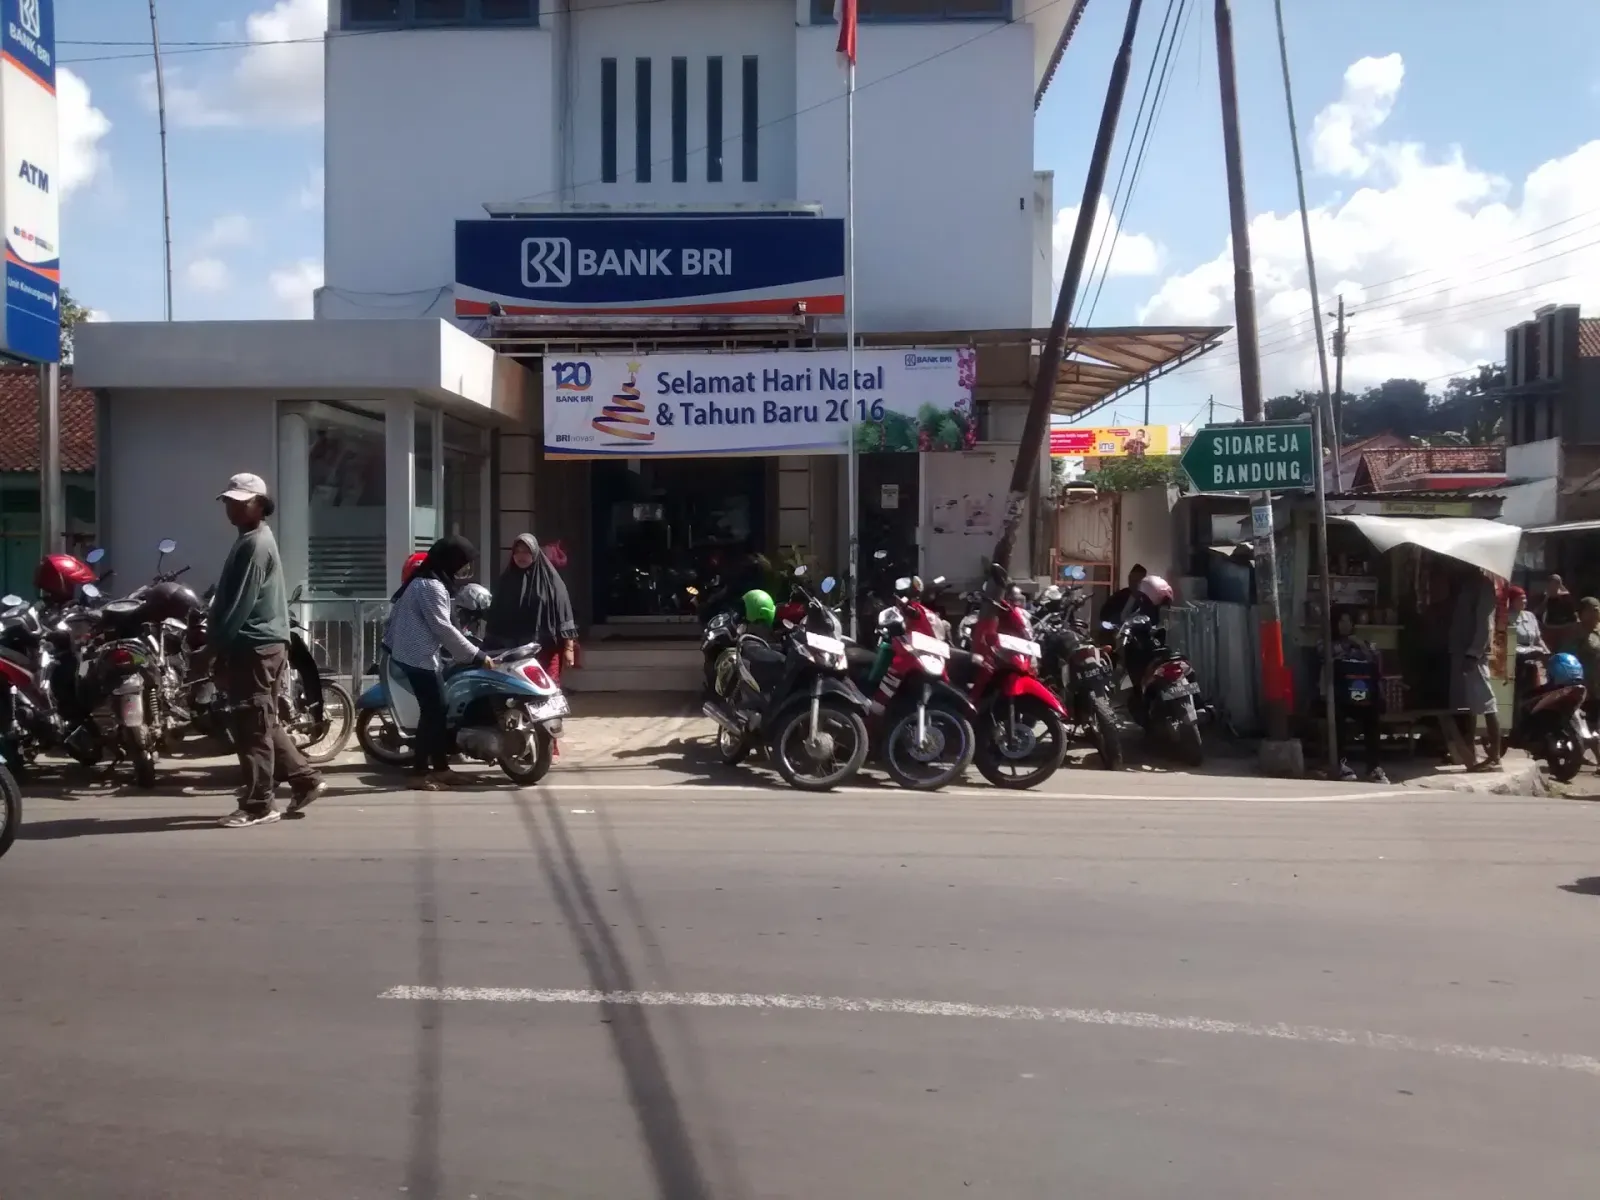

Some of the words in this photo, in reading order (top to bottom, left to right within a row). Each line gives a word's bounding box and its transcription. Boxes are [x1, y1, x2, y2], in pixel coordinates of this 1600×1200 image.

[9, 21, 36, 55] BANK
[37, 44, 51, 67] BRI
[19, 160, 49, 193] ATM
[577, 248, 672, 276] BANK
[682, 248, 732, 276] BRI
[939, 355, 952, 363] BRI
[551, 362, 592, 391] 120
[657, 370, 756, 395] Selamat
[763, 367, 811, 392] Hari
[819, 365, 883, 391] Natal
[556, 395, 579, 403] BANK
[580, 395, 594, 403] BRI
[656, 402, 674, 426] &
[680, 401, 755, 426] Tahun
[763, 400, 818, 424] Baru
[825, 398, 885, 423] 2016
[1213, 433, 1299, 456] SIDAREJA
[1213, 461, 1300, 484] BANDUNG
